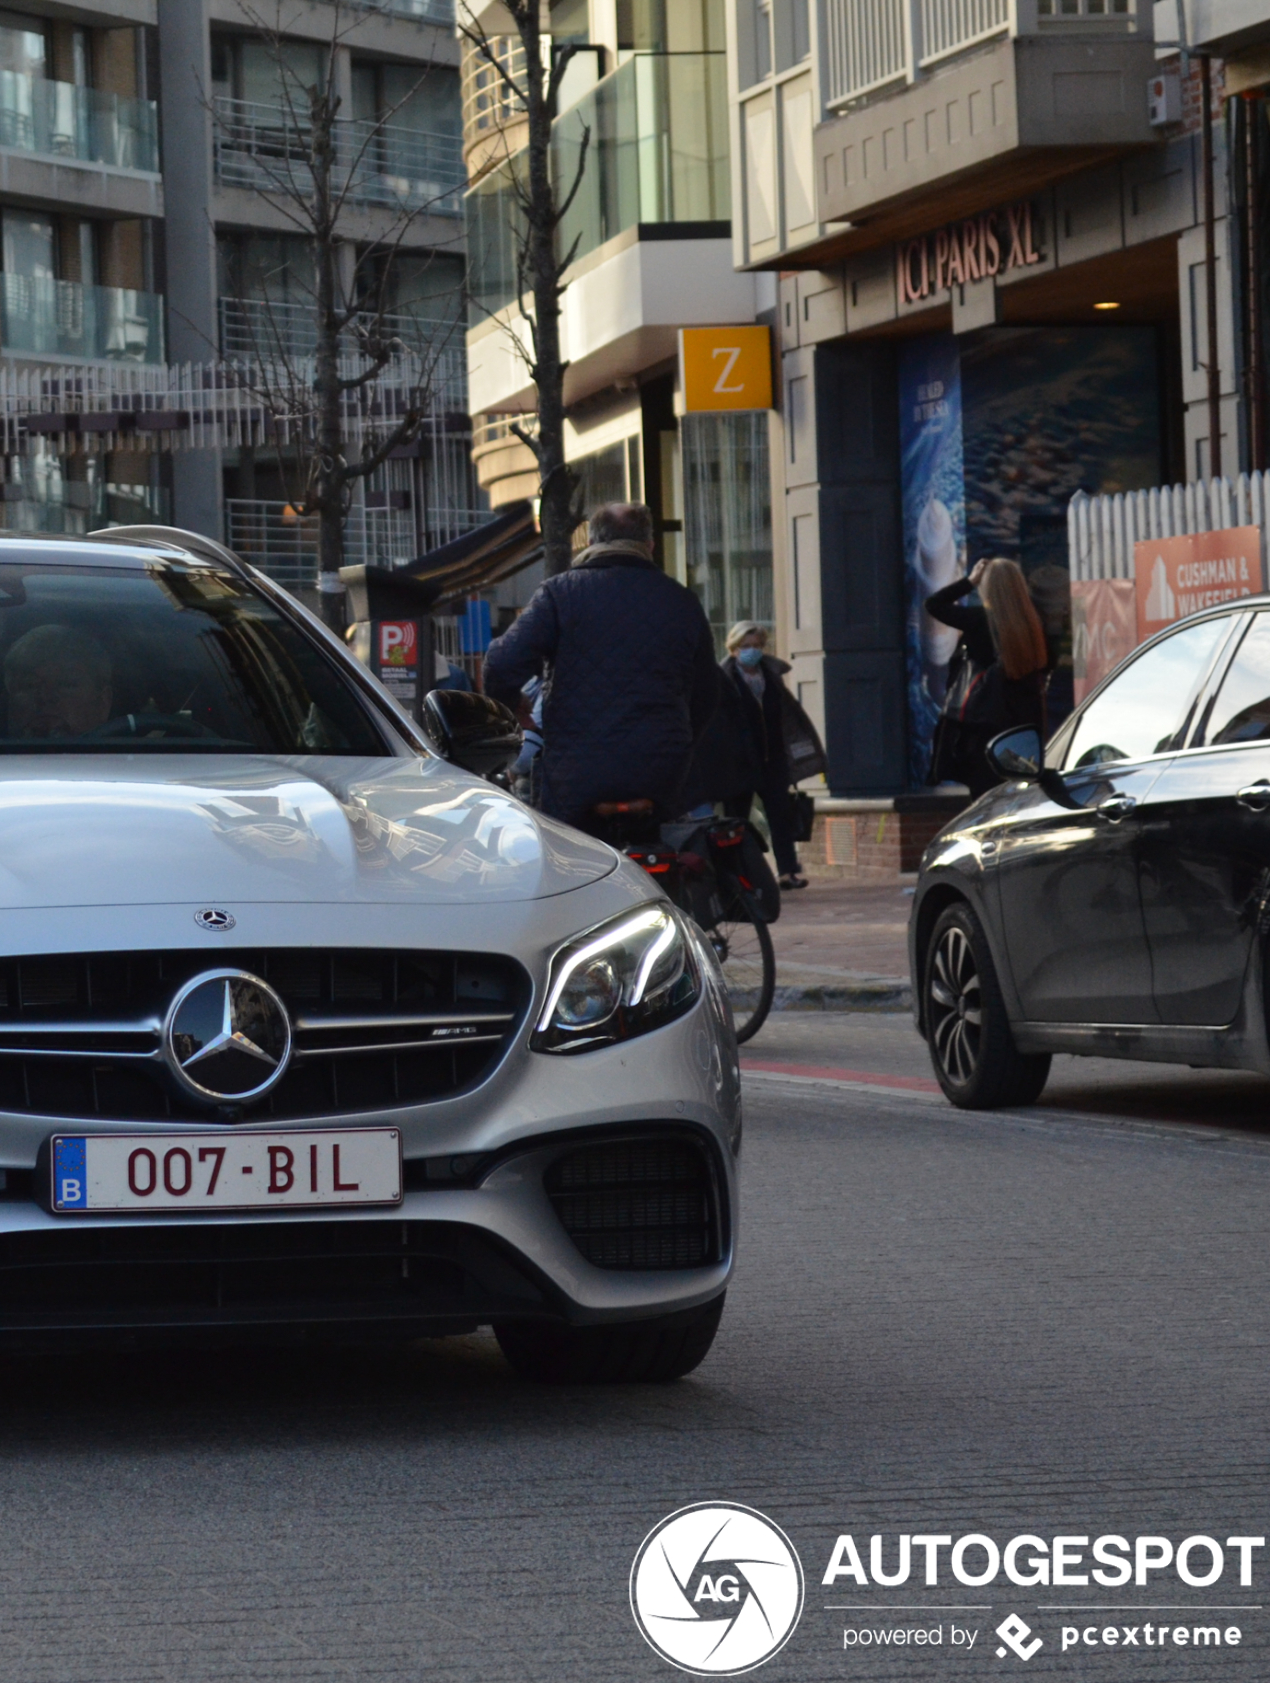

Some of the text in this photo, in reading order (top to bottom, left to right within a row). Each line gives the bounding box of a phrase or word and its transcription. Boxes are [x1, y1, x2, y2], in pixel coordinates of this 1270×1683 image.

[897, 203, 1039, 303] ICI PARIS XL
[712, 347, 745, 393] Z
[1176, 556, 1250, 588] CUSHMAN &
[382, 625, 404, 660] P
[62, 1179, 81, 1201] B
[127, 1143, 360, 1197] 007-BIL
